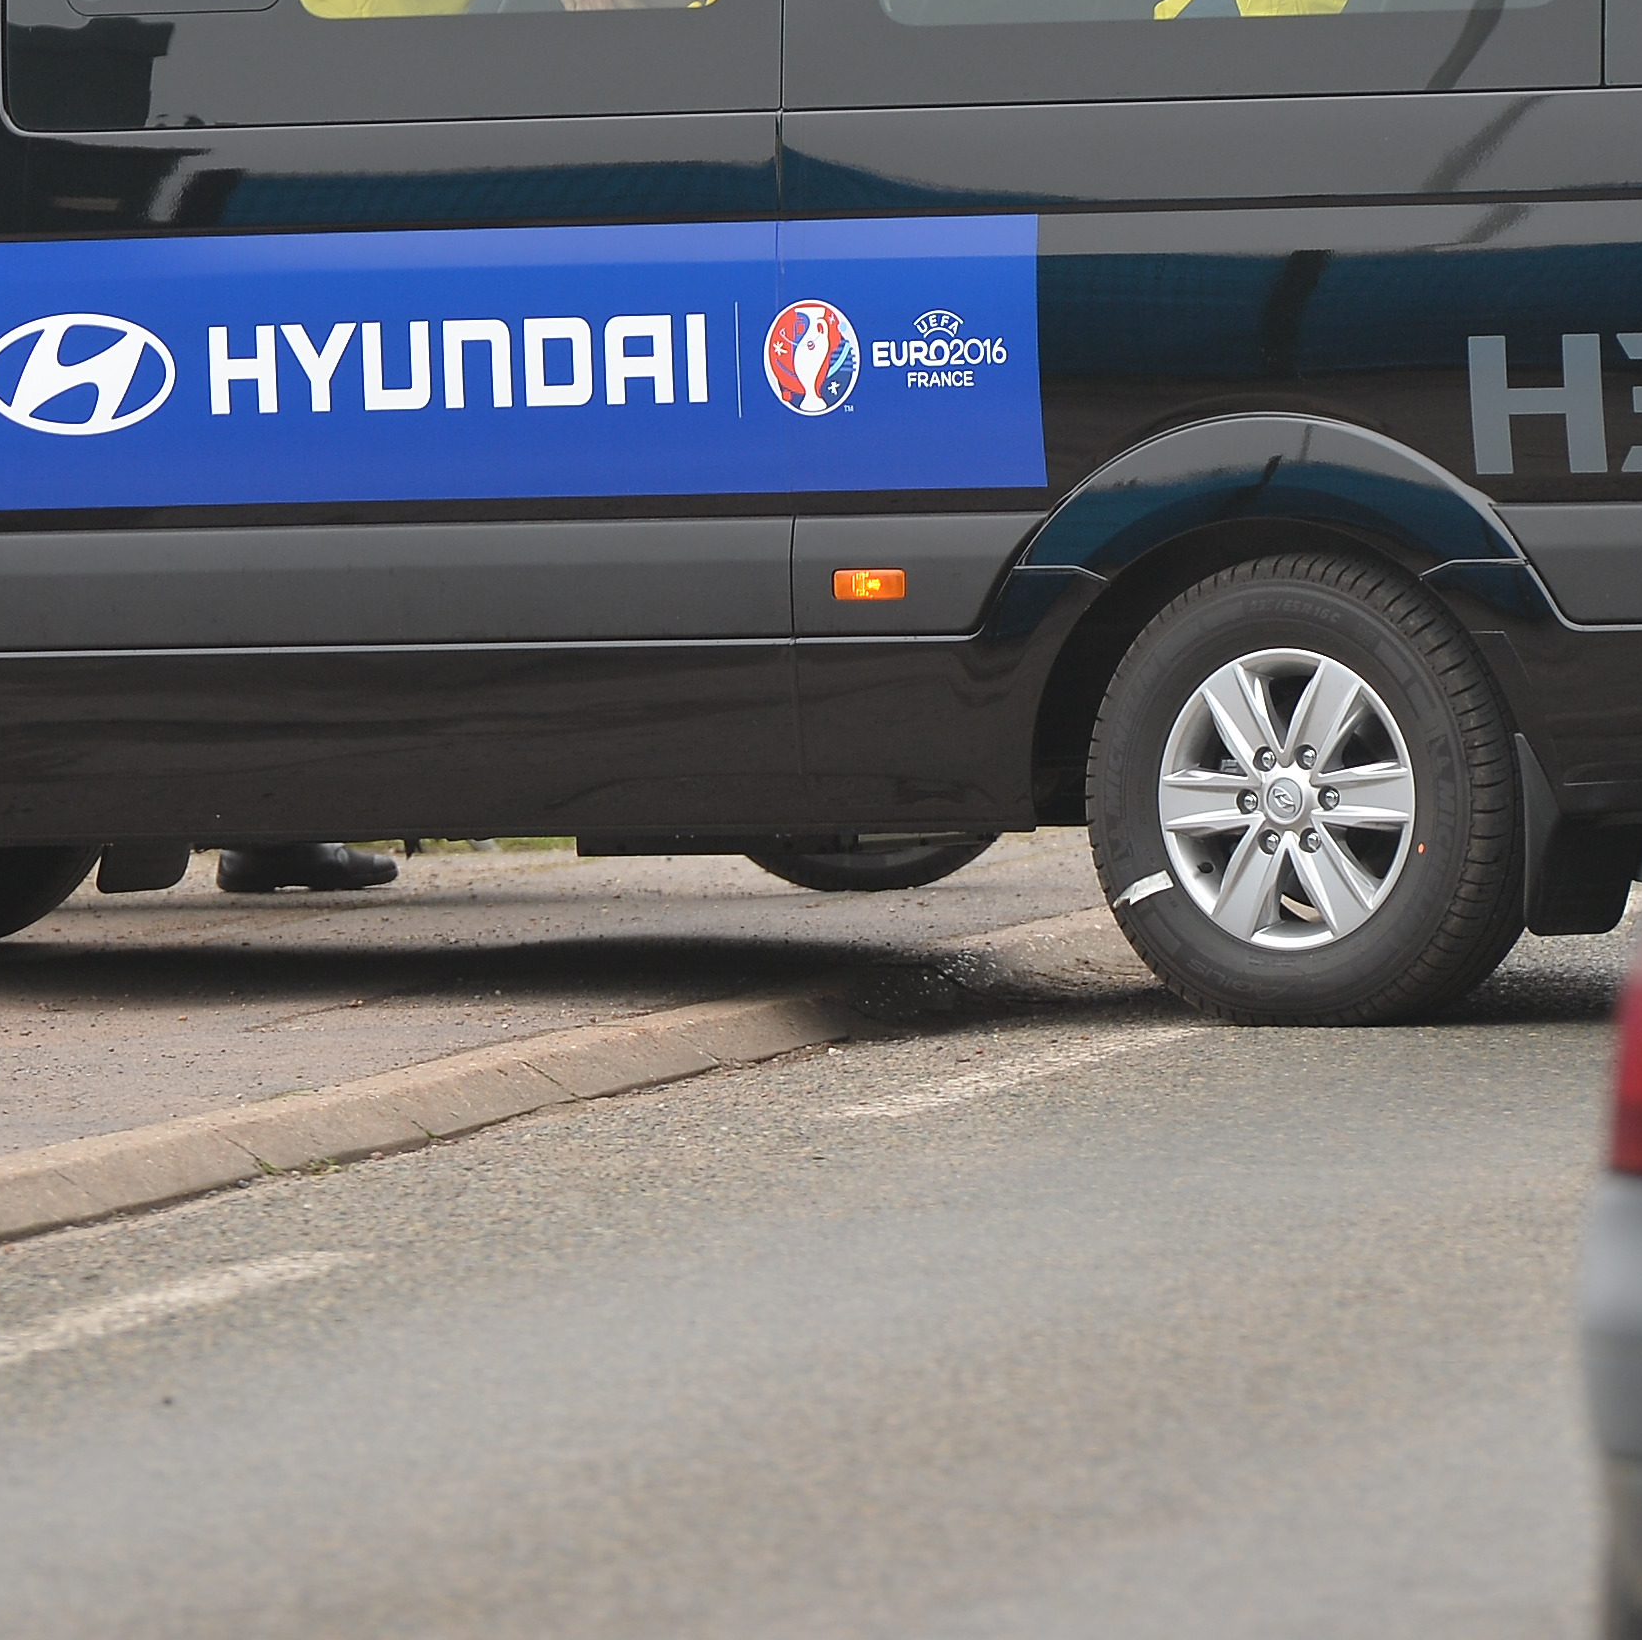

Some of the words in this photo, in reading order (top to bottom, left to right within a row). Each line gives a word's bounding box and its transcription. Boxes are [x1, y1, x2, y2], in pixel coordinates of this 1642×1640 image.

[915, 313, 960, 335] UEFA
[208, 312, 709, 415] HYUNDAI
[872, 336, 1008, 368] EURO2016
[907, 370, 975, 388] FRANCE
